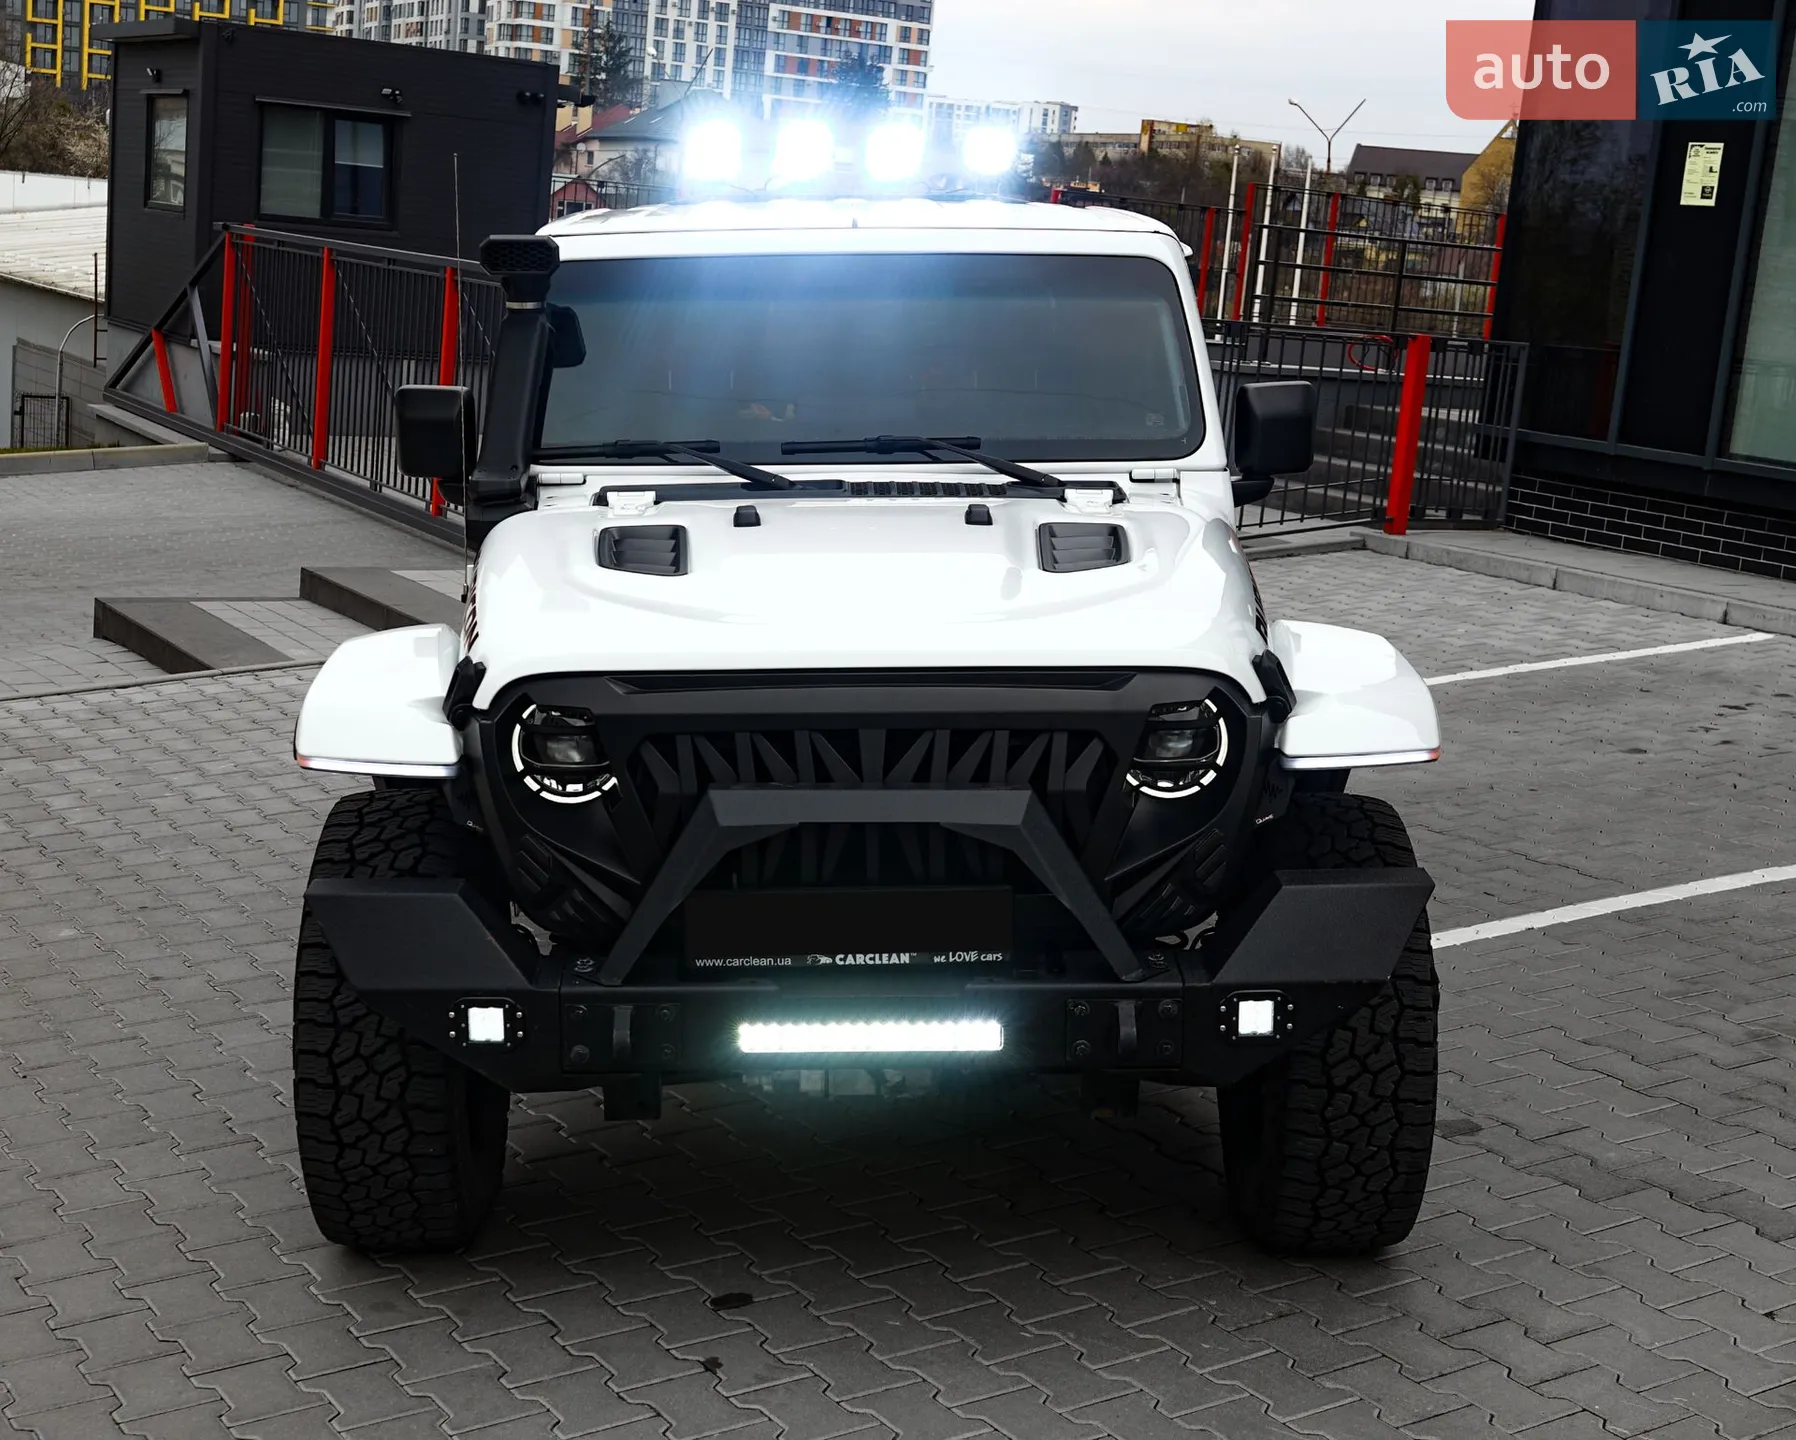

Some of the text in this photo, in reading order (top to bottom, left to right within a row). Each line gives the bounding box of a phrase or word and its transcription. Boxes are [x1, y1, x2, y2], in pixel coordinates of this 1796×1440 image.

[695, 956, 792, 967] www.carclean.ua
[933, 951, 1003, 963] we LOVE cars
